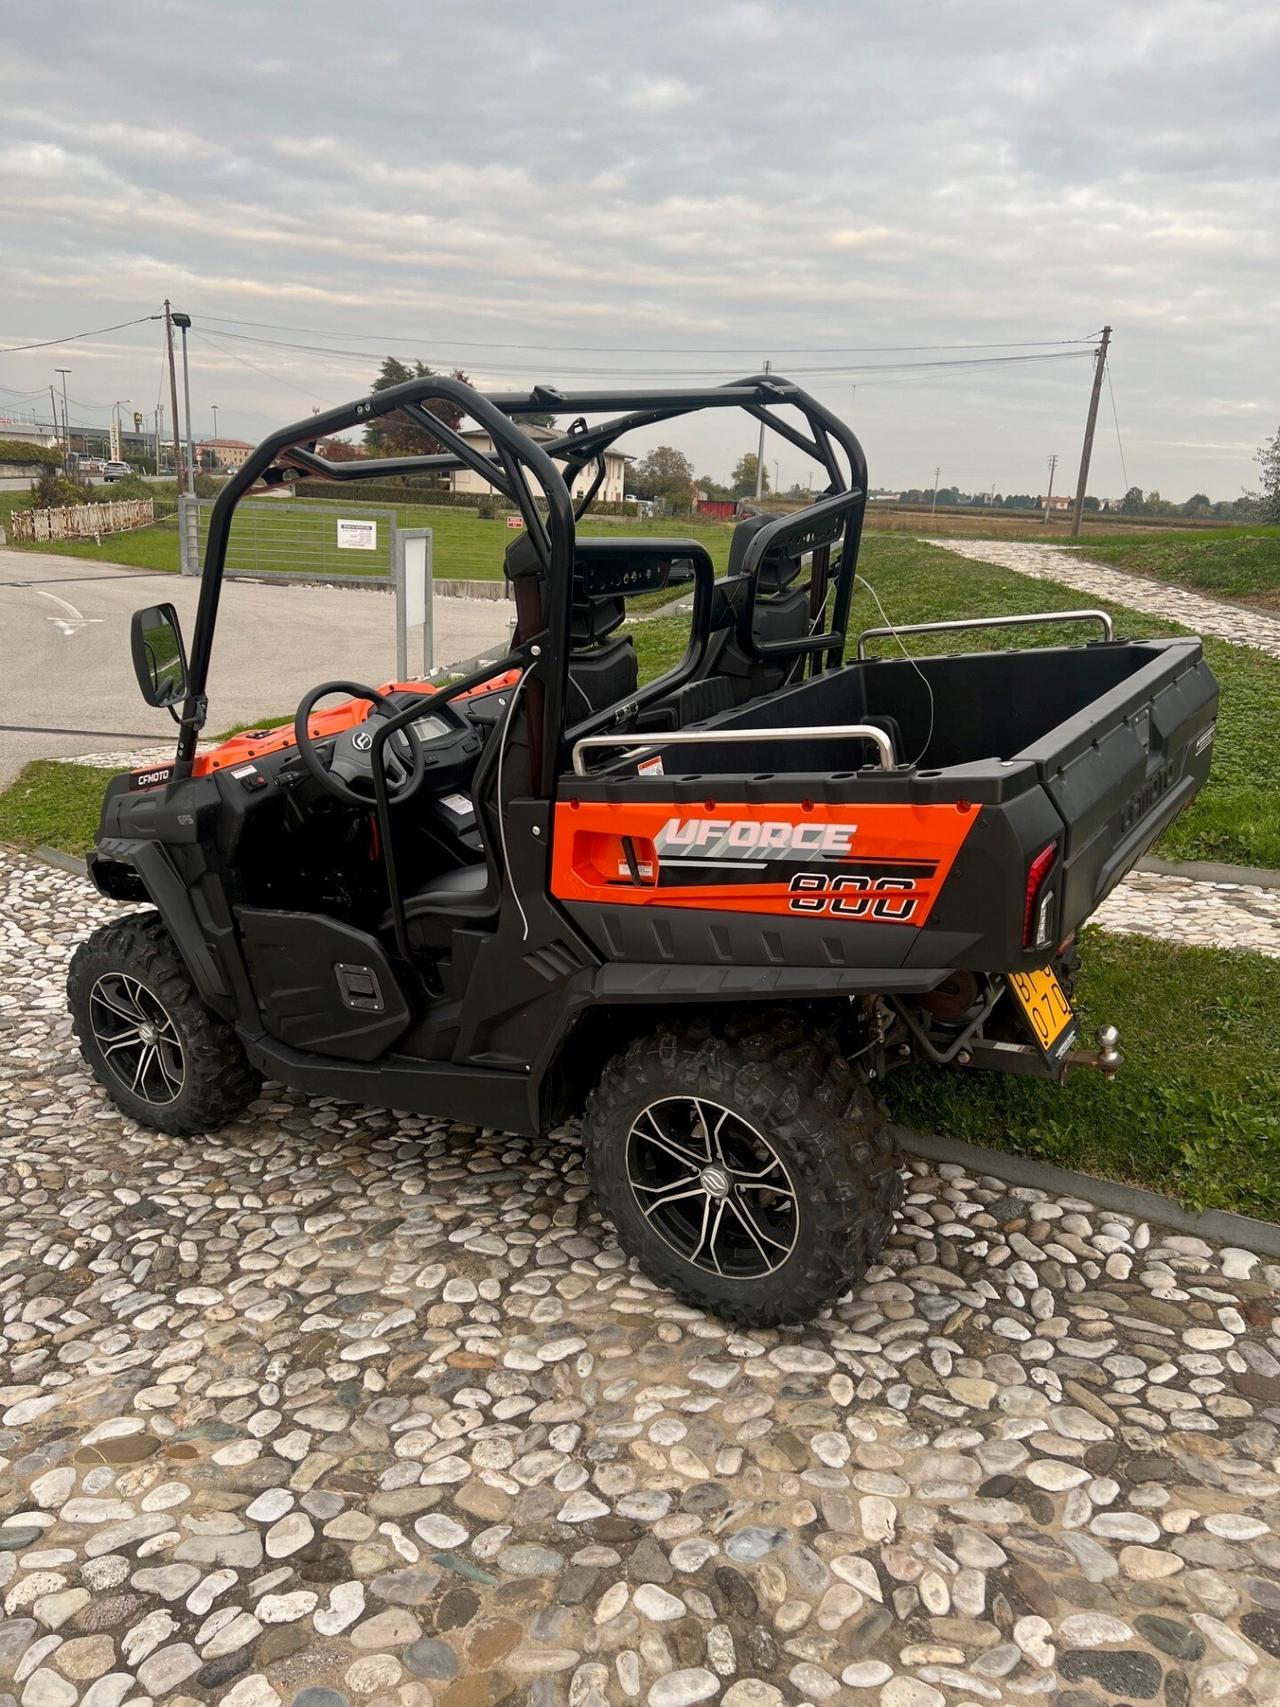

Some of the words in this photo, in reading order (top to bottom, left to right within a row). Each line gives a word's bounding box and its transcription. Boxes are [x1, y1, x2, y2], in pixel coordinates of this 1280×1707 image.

[138, 770, 169, 785] CFMOTO
[664, 818, 858, 852] UFORCE
[788, 872, 918, 921] 800
